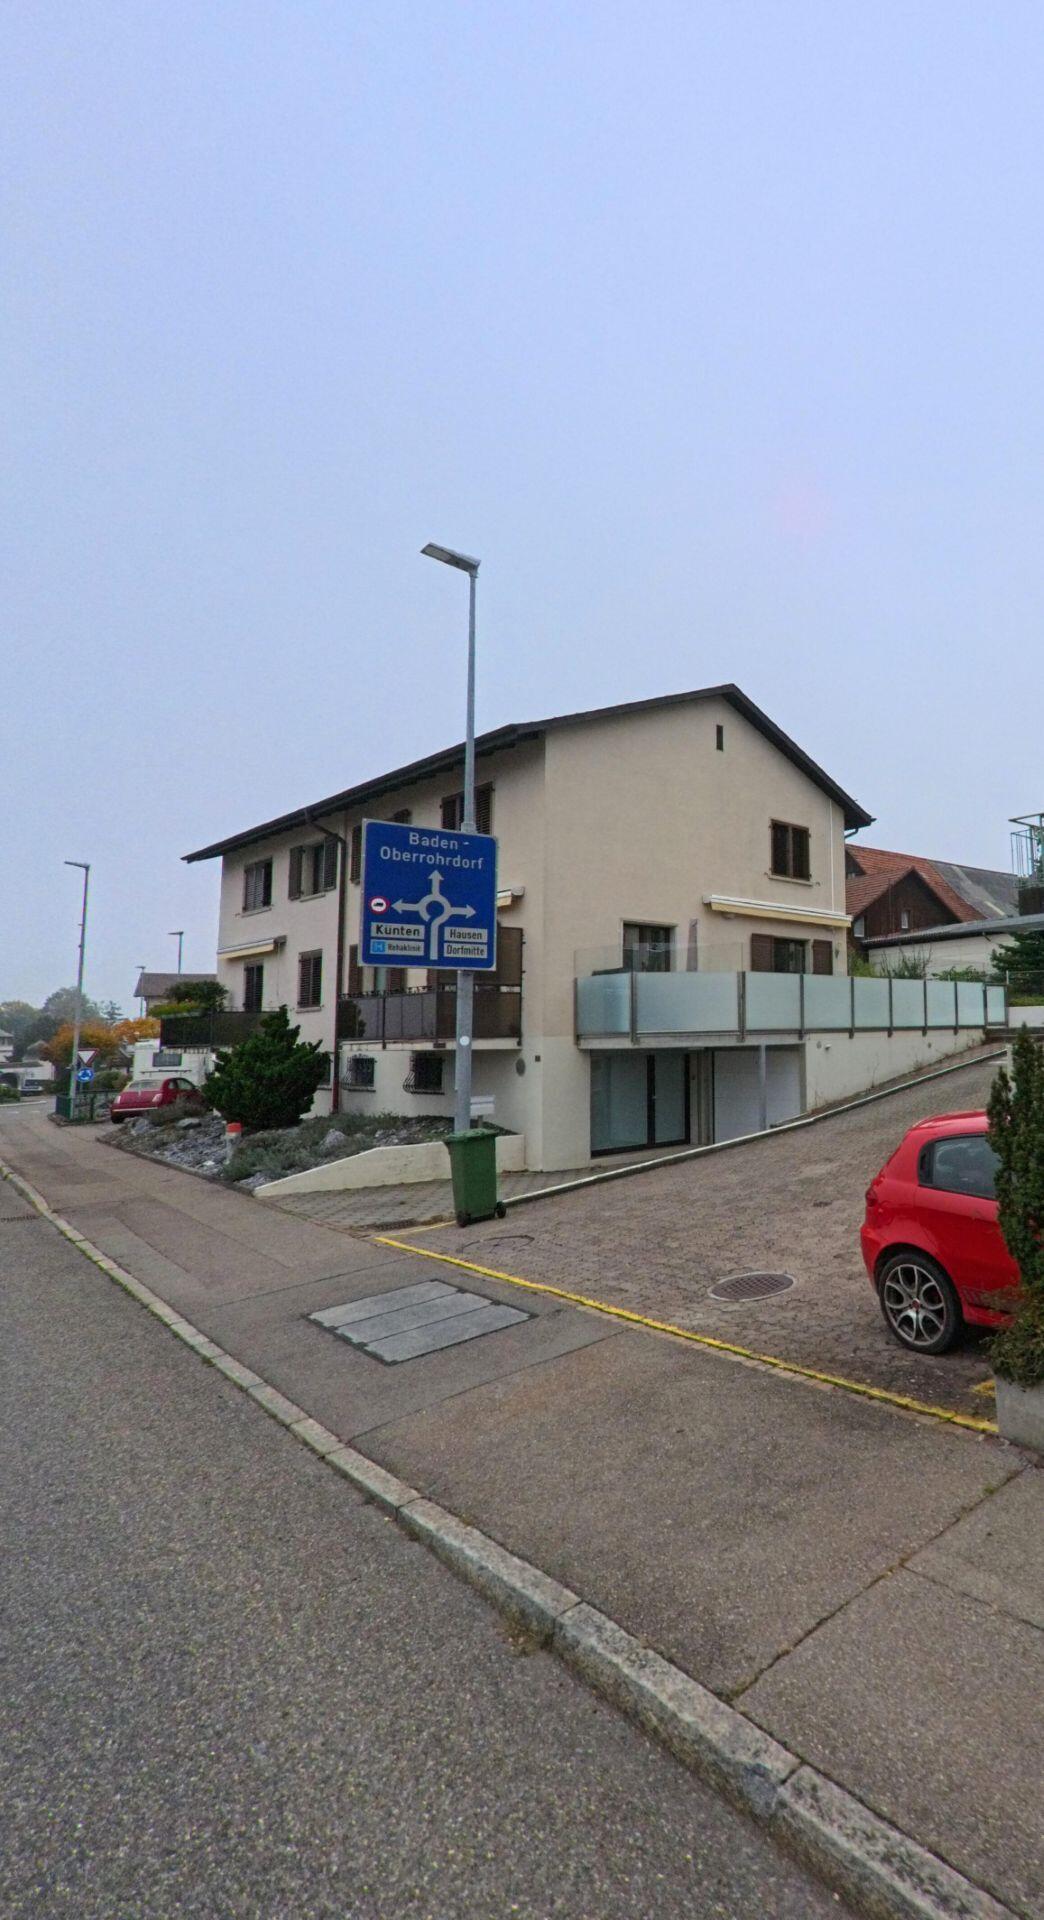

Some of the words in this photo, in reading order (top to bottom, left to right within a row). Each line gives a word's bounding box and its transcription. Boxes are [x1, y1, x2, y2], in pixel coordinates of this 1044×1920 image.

[409, 832, 458, 849] Baden
[380, 846, 484, 869] Oberrohrdorf
[450, 929, 482, 940] Hausen
[446, 945, 485, 956] Dorfmitte
